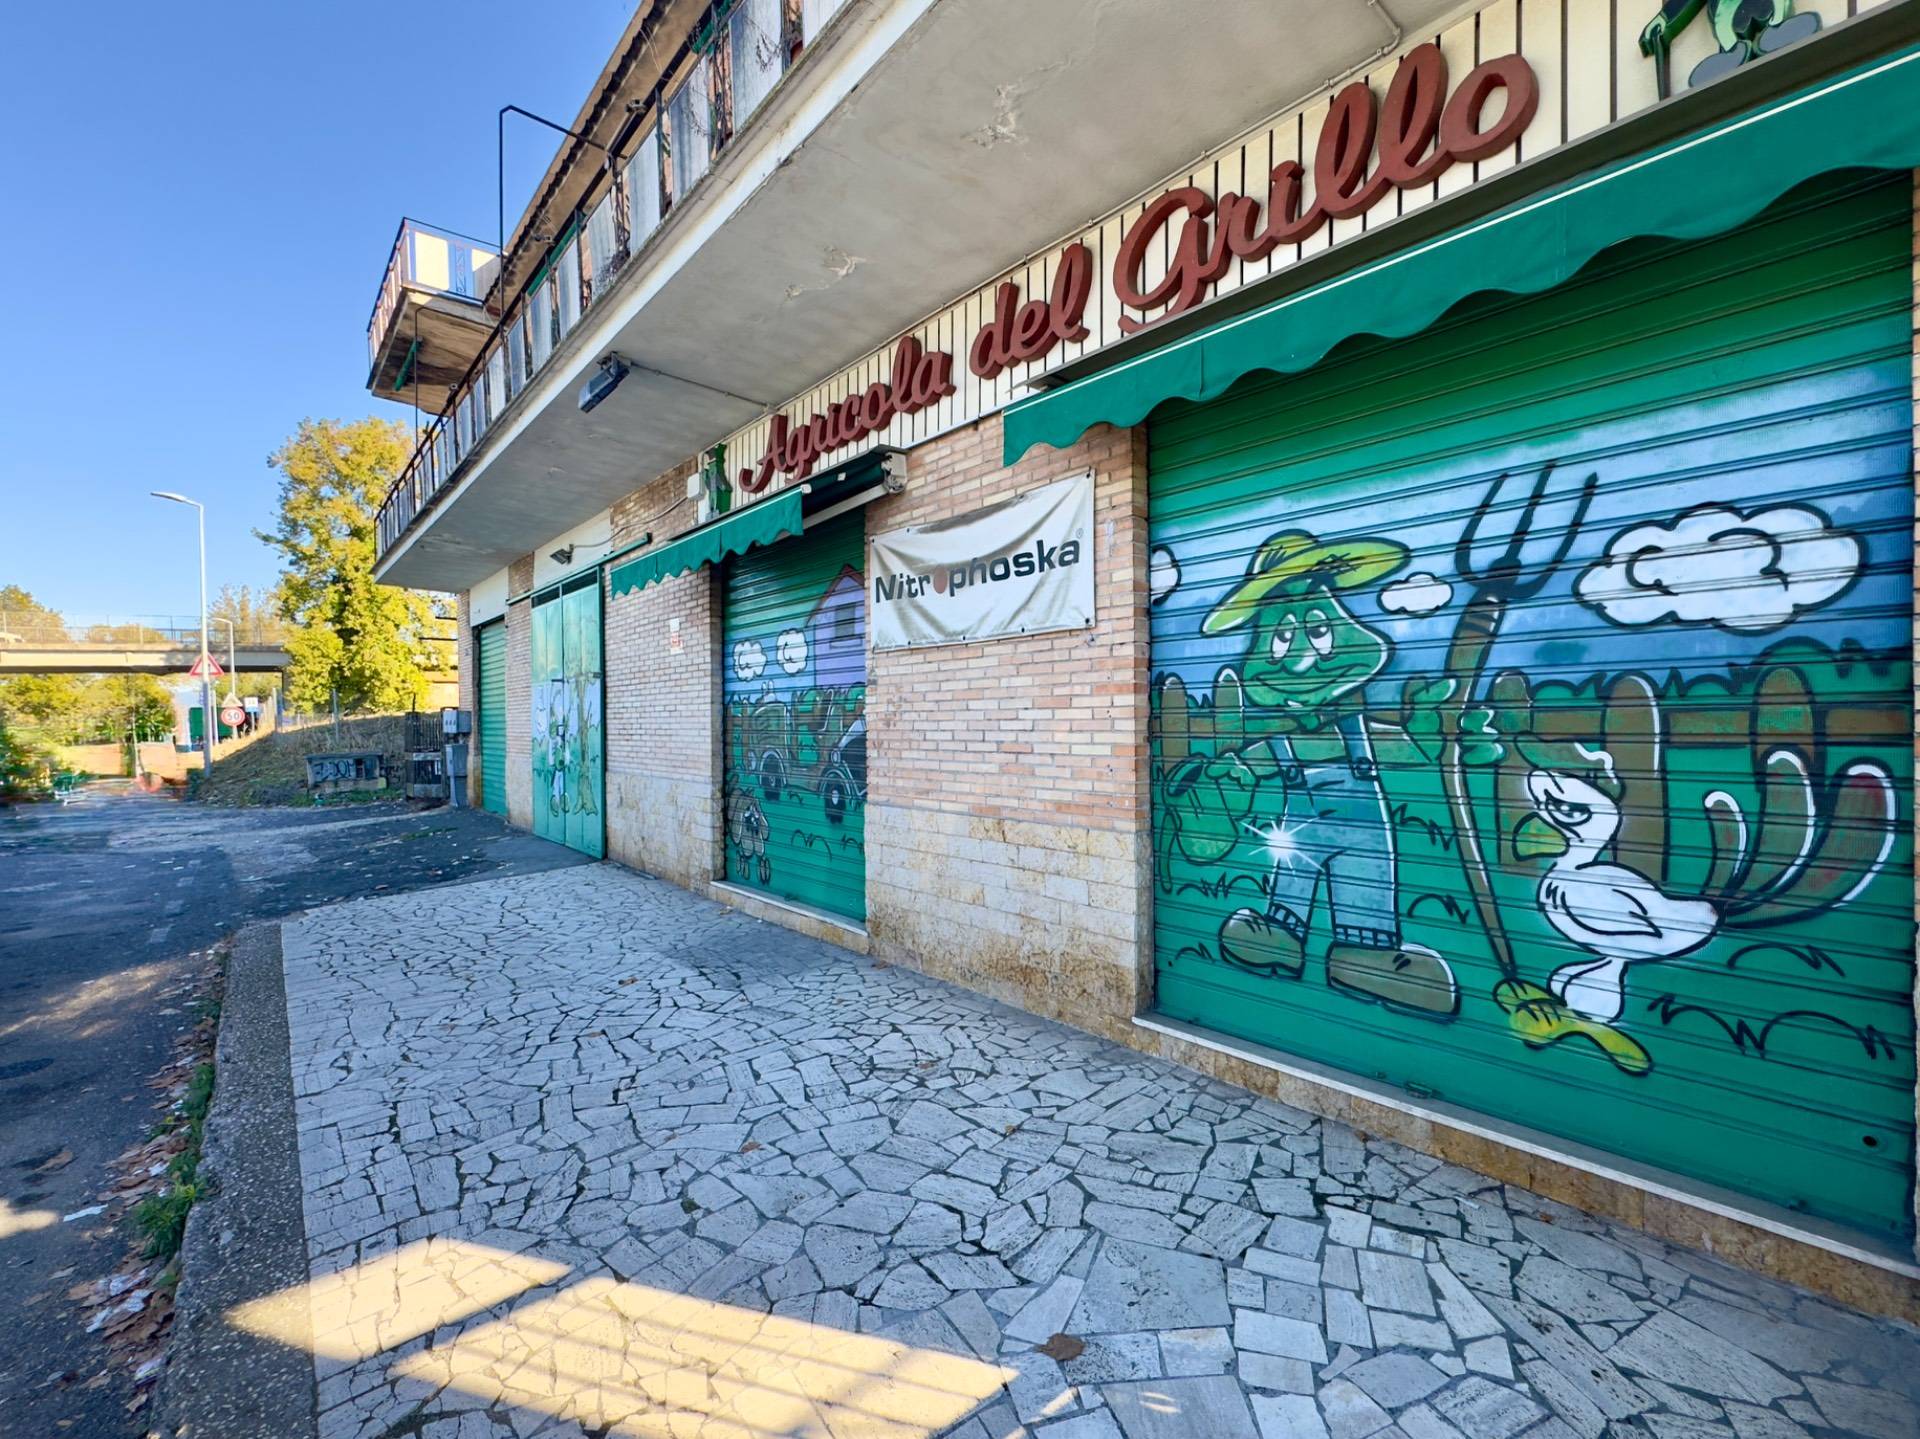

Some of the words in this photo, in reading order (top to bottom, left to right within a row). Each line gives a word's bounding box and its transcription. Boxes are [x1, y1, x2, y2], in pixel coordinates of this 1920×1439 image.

[739, 335, 957, 493] Agricola
[970, 282, 1090, 379] del
[1113, 43, 1539, 333] Grillo
[227, 711, 240, 721] 50
